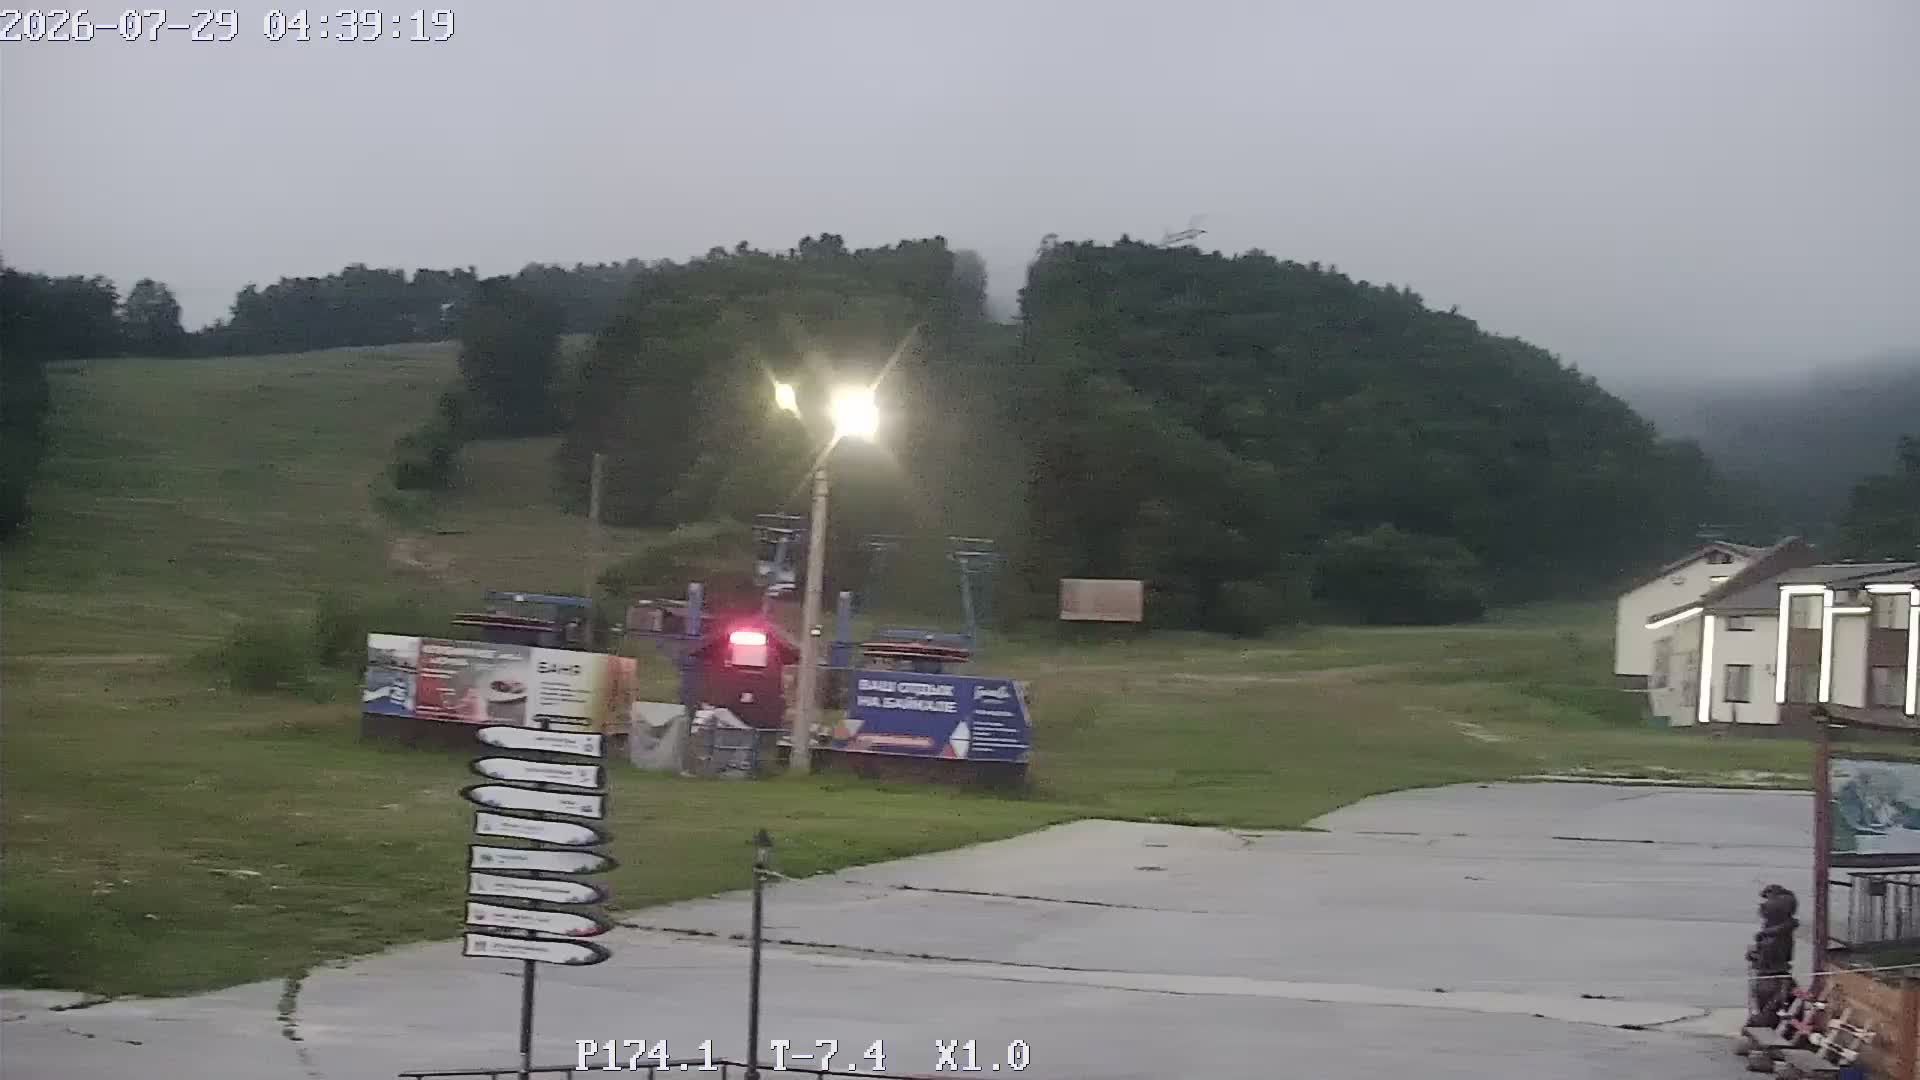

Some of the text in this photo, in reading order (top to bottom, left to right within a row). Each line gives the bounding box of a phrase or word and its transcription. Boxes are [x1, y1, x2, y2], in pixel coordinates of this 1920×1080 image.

[858, 679, 897, 692] ВАШ
[856, 695, 881, 707] НА
[882, 697, 958, 713] БАЙКАЛЕ
